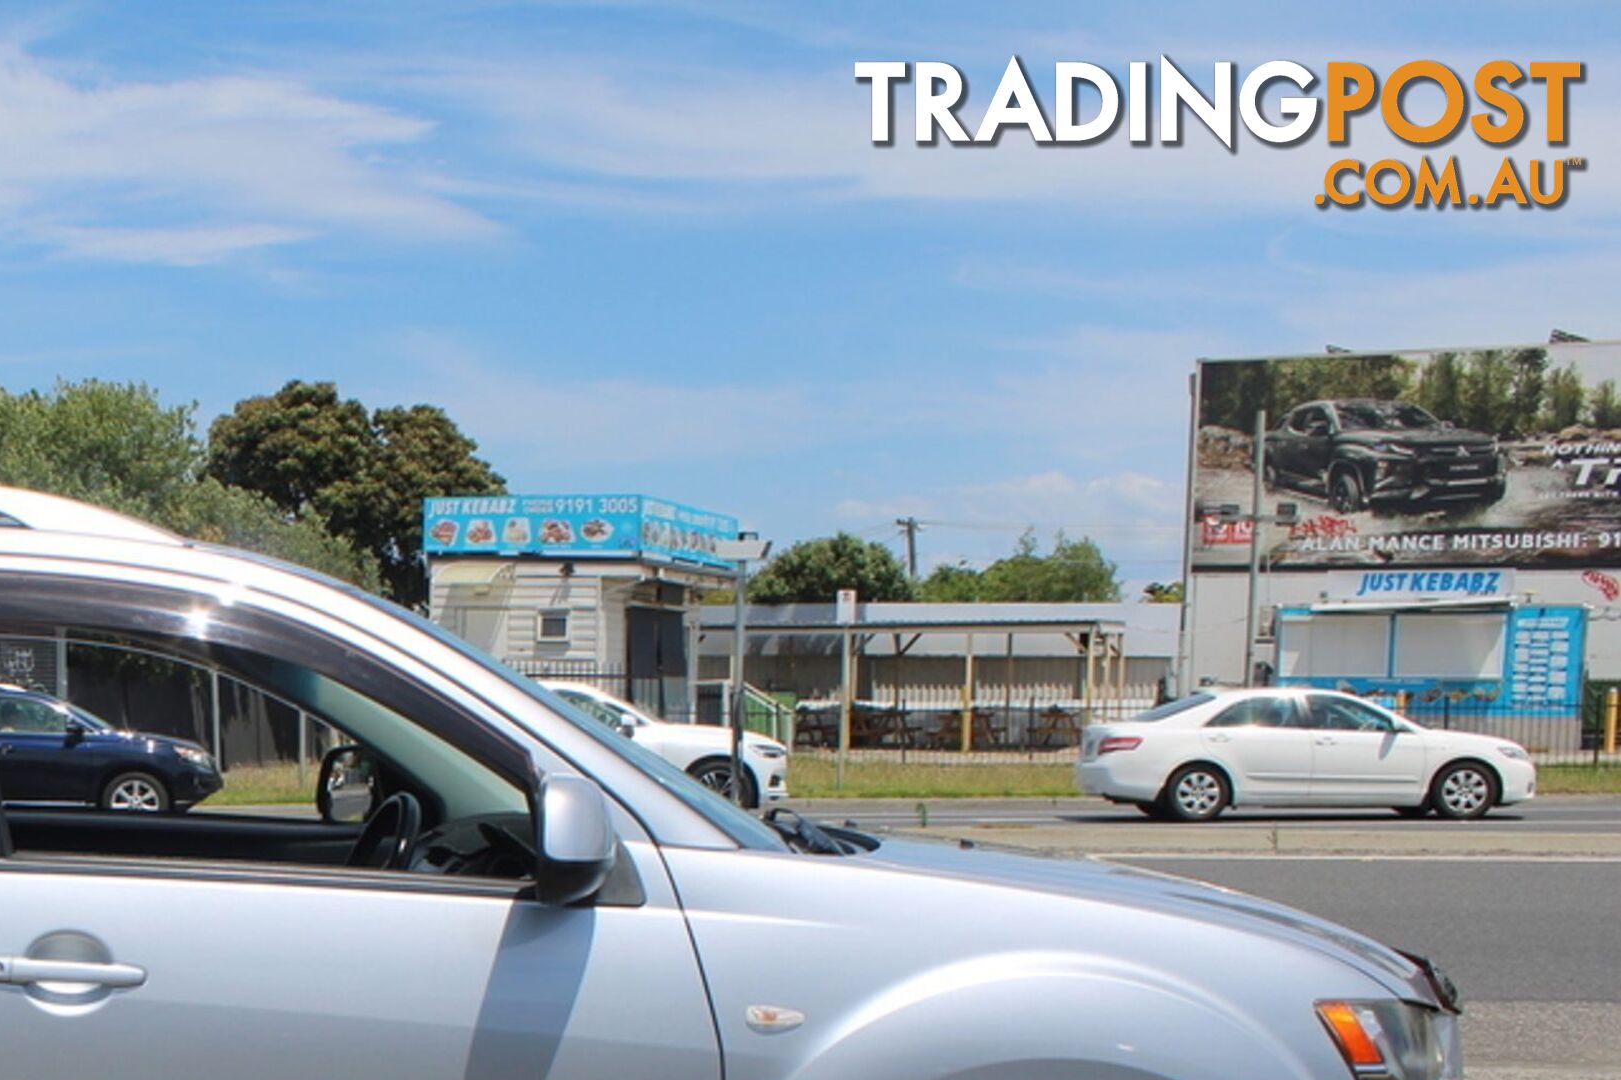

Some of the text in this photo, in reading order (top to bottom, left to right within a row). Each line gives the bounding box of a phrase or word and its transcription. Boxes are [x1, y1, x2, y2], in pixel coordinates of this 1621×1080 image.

[429, 500, 459, 518] JUST
[462, 499, 516, 515] KEBABZ
[555, 499, 593, 515] 9191
[598, 498, 638, 514] 3005
[1301, 536, 1360, 551] ALAN
[1368, 534, 1446, 551] MANCE
[1356, 572, 1502, 595] JUST KEBABZ
